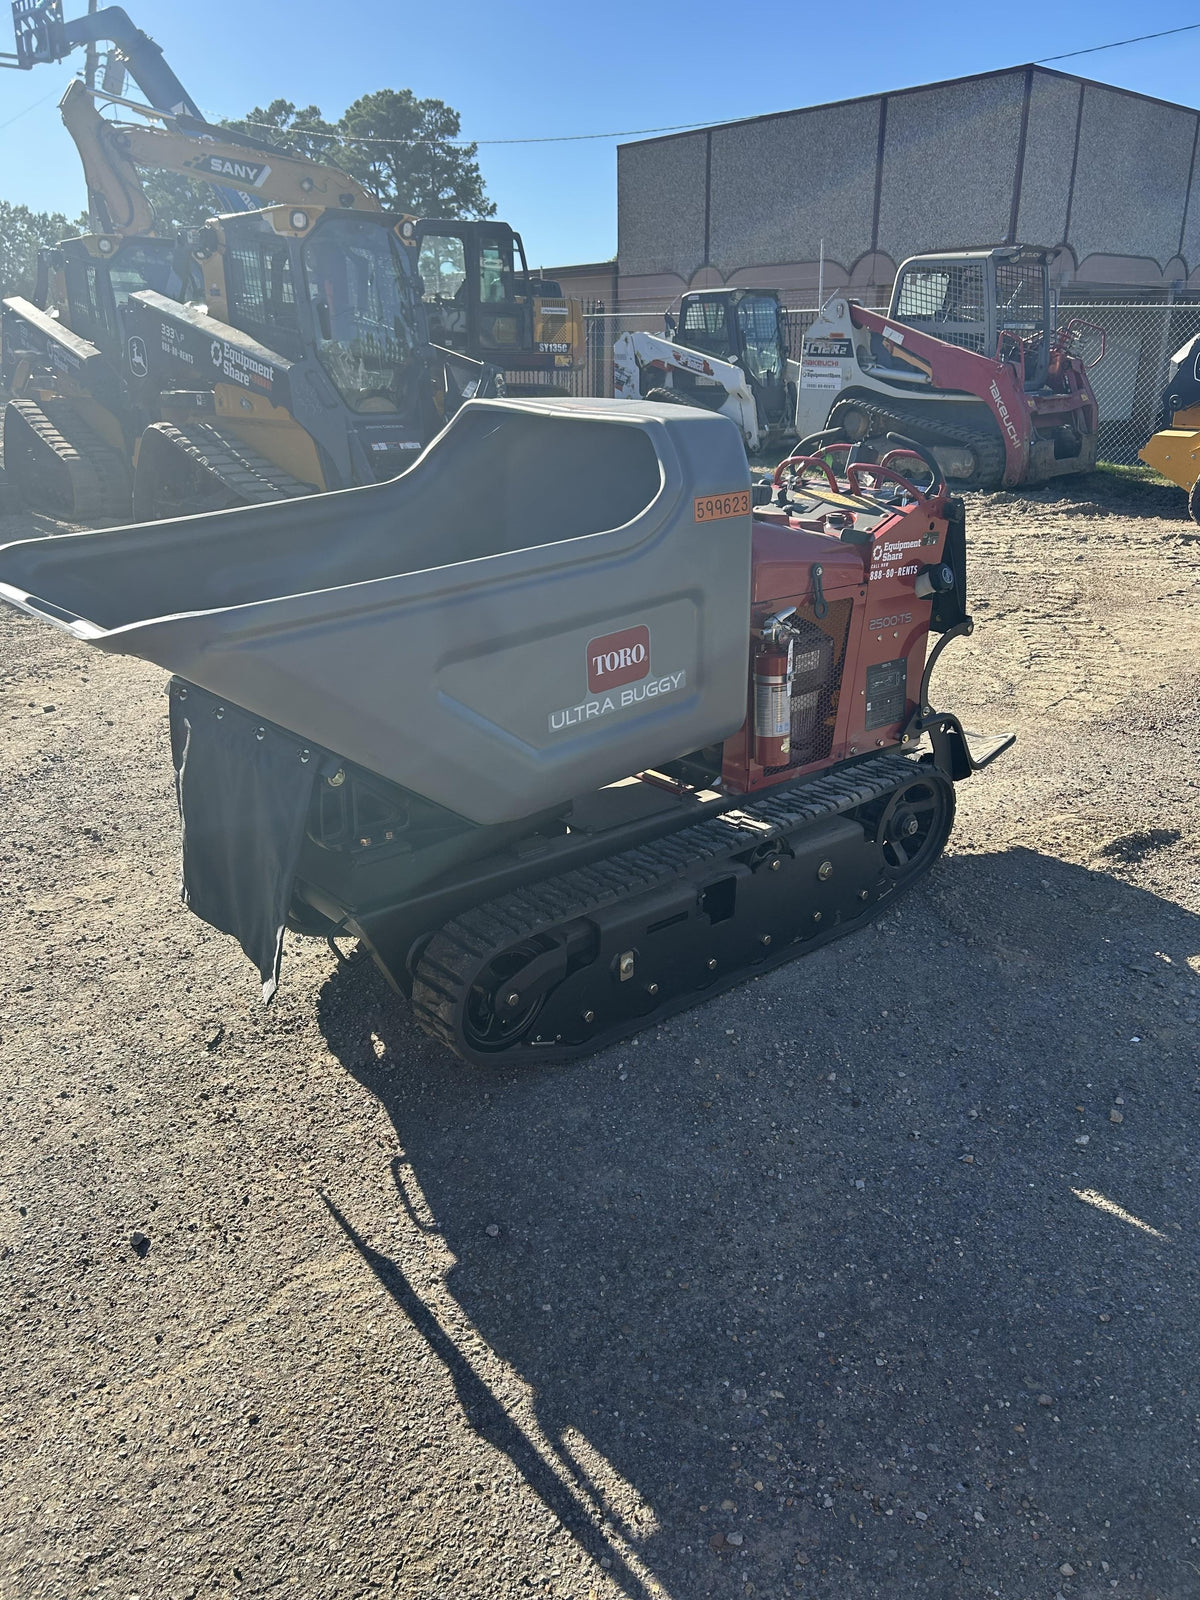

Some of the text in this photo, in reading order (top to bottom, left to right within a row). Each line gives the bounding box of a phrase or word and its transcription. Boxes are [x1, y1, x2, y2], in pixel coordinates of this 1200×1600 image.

[210, 158, 258, 180] SANY
[161, 323, 175, 339] 333
[539, 343, 568, 352] SY135C
[223, 342, 274, 381] Equipment
[223, 361, 250, 386] Share
[697, 495, 748, 519] 599623
[883, 538, 922, 552] Equipment
[882, 552, 903, 562] Share
[869, 565, 918, 581] 888-80-RENTS
[592, 643, 646, 676] TORO
[551, 672, 682, 729] ULTRA BUGGY
